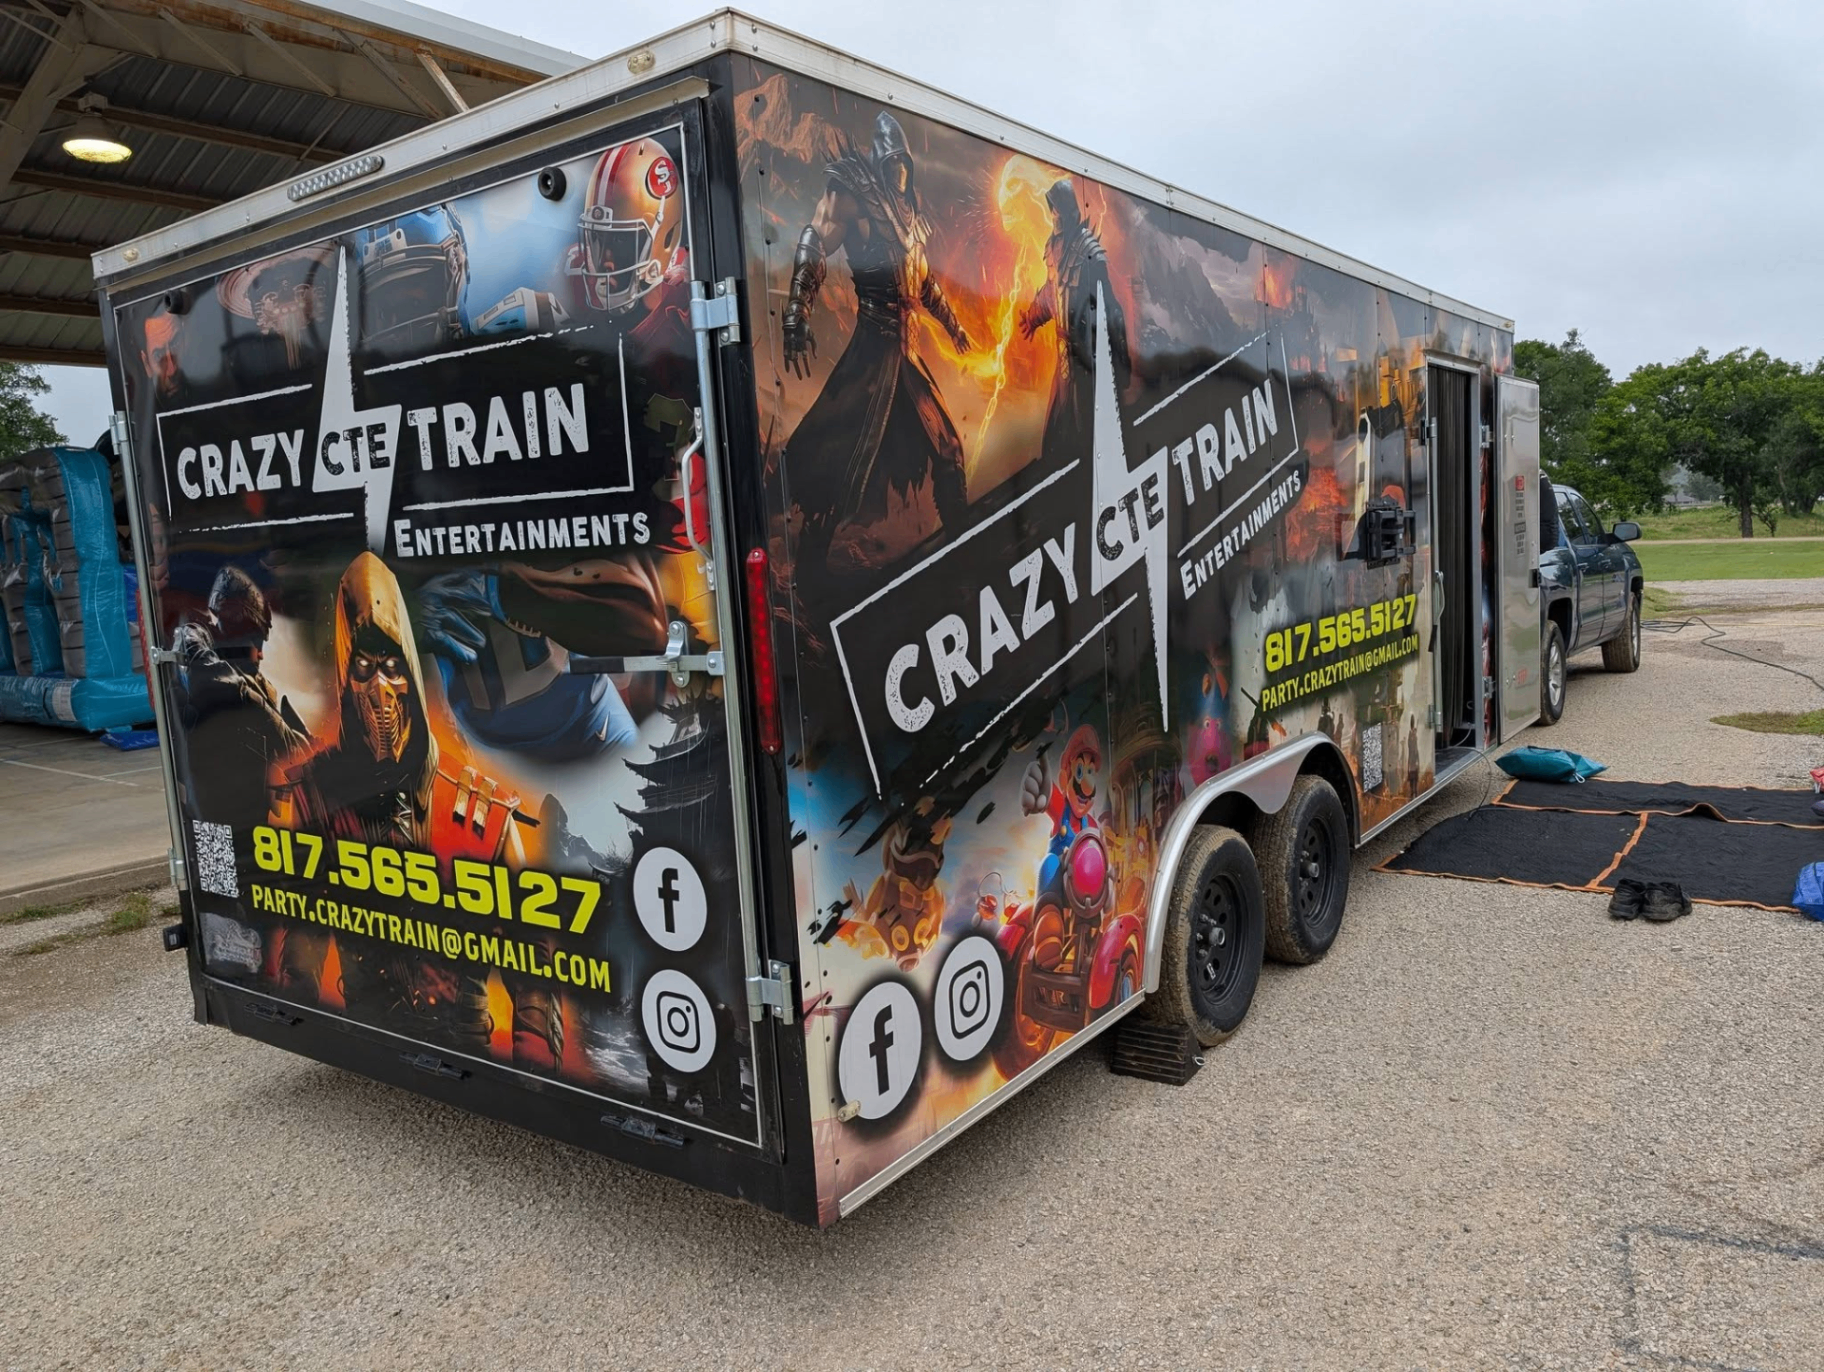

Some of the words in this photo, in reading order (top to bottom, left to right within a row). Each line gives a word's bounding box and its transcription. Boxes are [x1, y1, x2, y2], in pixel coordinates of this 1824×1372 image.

[178, 429, 304, 500] CRAZY
[320, 422, 390, 476] CTE
[407, 383, 589, 471] TRAIN
[394, 511, 651, 557] ENTERTAINMENTS
[885, 522, 1079, 732] CRAZY
[1097, 472, 1165, 561] CTE
[1172, 379, 1278, 506] TRAIN
[1180, 470, 1302, 600] ENTERTAINMENTS
[1261, 634, 1419, 712] PARTY.CRAZYTRAIN@GMAIL.COM
[1265, 593, 1418, 673] 817.565.5127
[252, 825, 602, 934] 817.565.5127
[251, 884, 611, 993] PARTY.CRAZYTRAIN@GMAIL.COM
